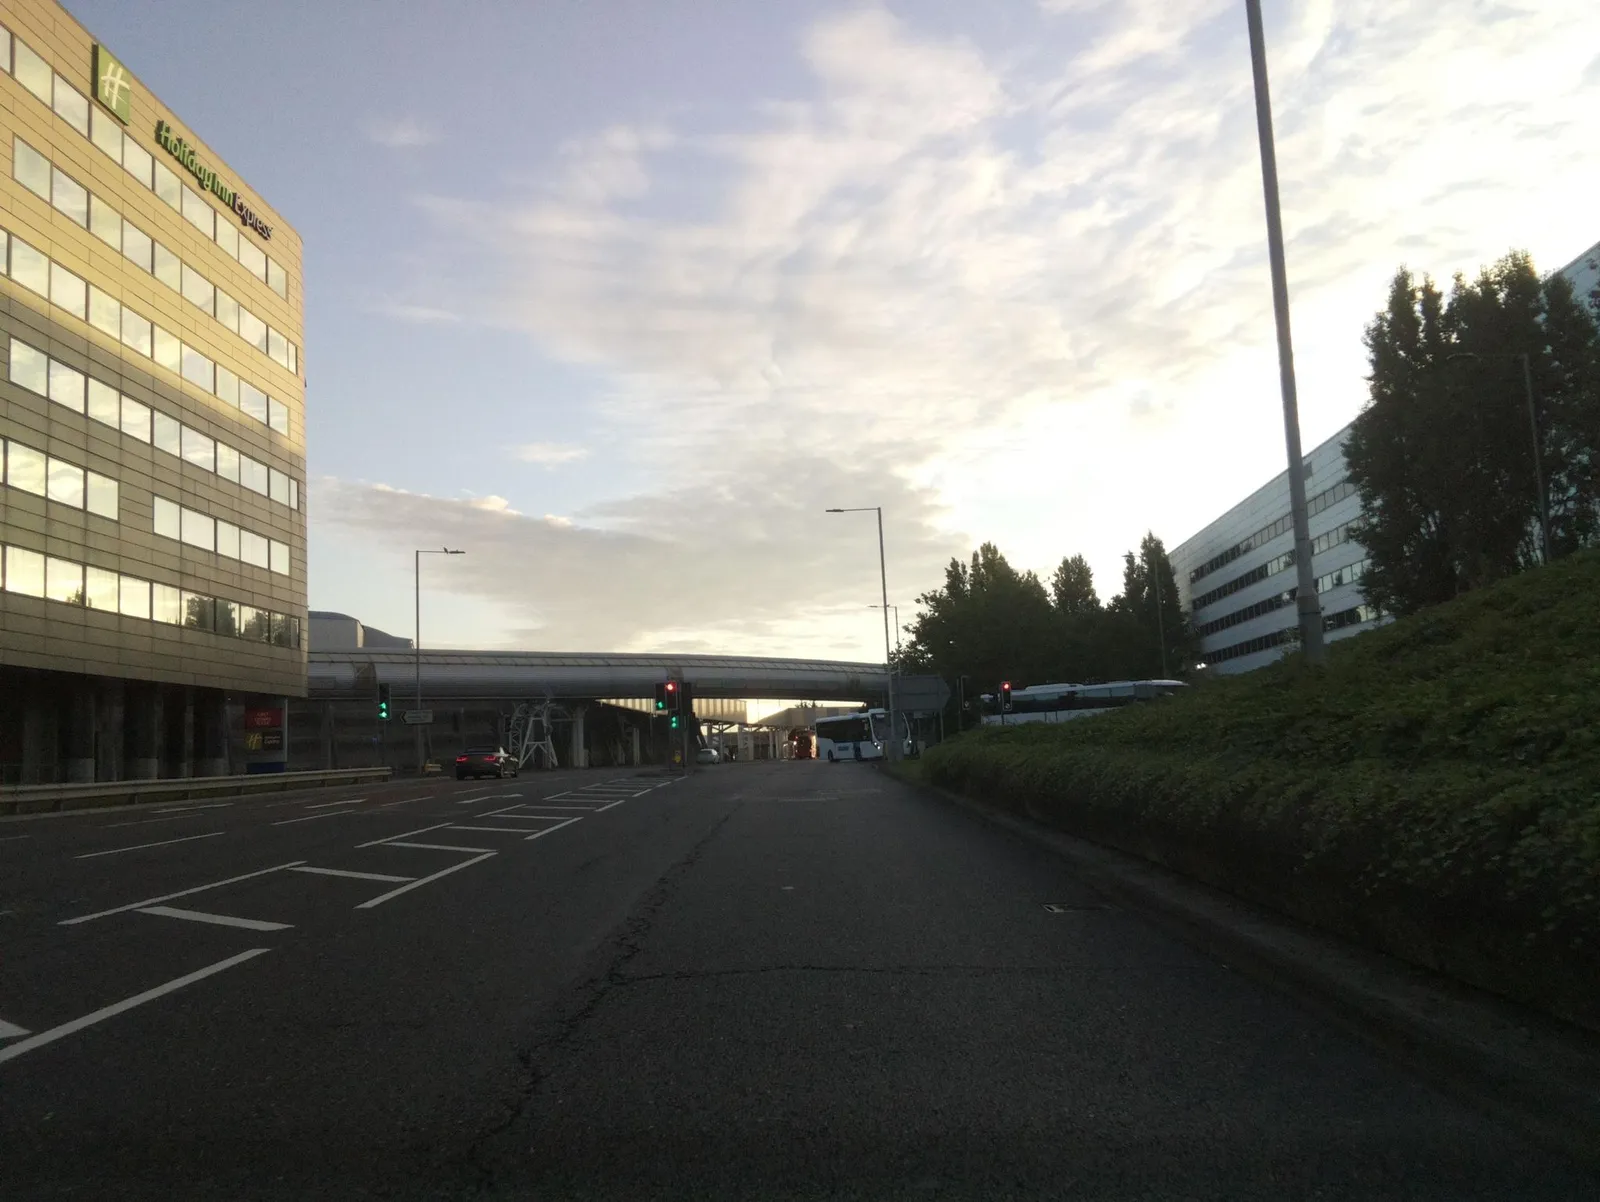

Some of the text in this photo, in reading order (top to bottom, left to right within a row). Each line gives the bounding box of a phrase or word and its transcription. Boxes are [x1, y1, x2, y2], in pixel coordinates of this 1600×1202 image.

[157, 120, 273, 241] Holiday Inn Express
